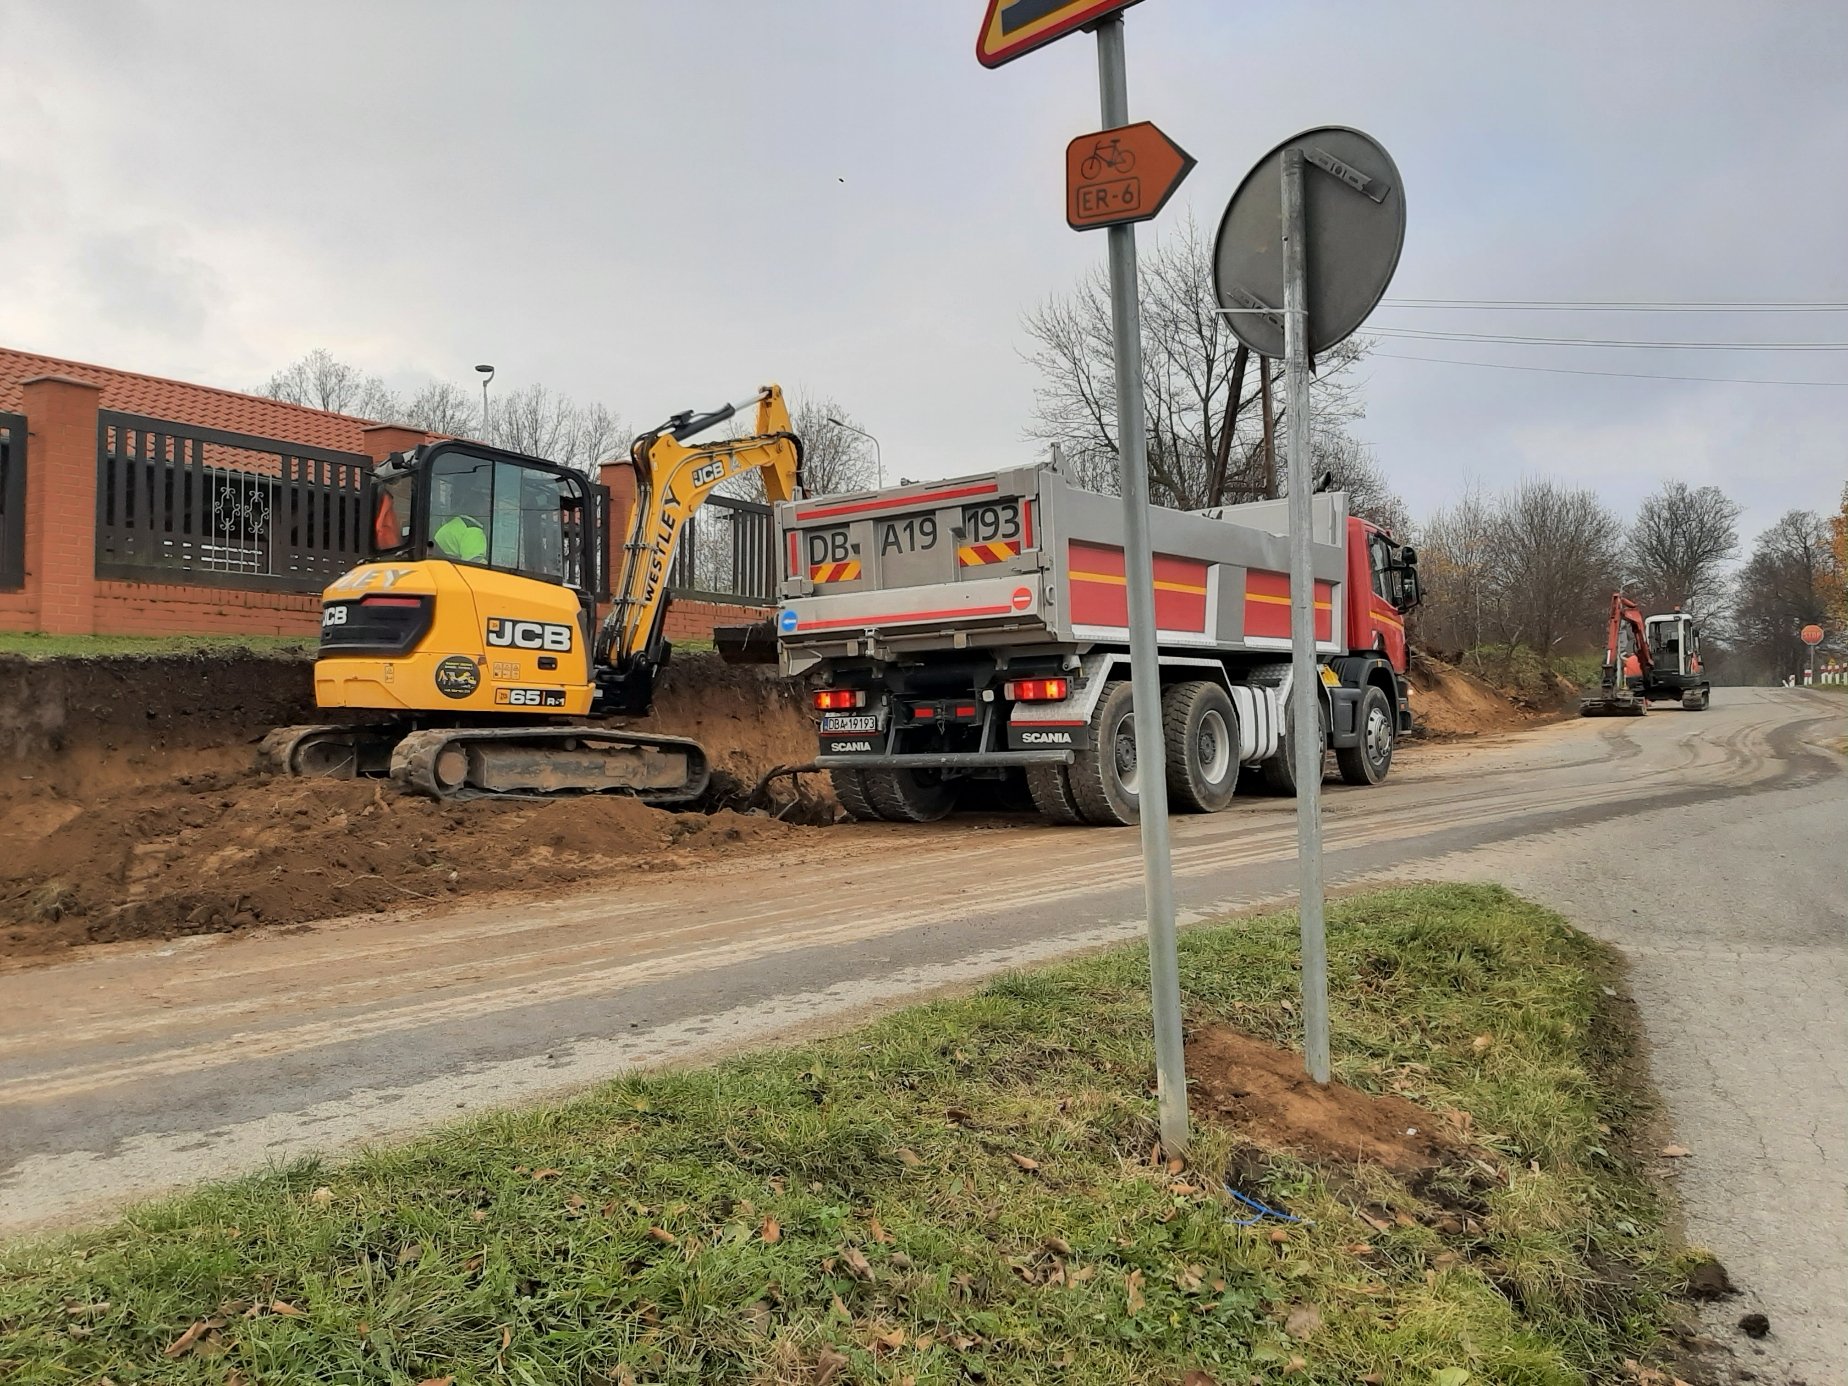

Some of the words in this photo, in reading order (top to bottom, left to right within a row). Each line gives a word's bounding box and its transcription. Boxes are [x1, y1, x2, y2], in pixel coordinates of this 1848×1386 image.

[1083, 183, 1134, 211] ER-6
[694, 461, 724, 487] JCB
[645, 485, 681, 602] WESTLEY
[809, 531, 849, 565] DB
[881, 516, 938, 556] A19
[967, 504, 1020, 543] 193
[488, 620, 571, 651] JCB
[1803, 631, 1822, 639] STOP
[510, 689, 540, 705] 65
[849, 717, 875, 729] 19193
[831, 741, 872, 752] SCANIA
[1022, 731, 1072, 743] SCANIA
